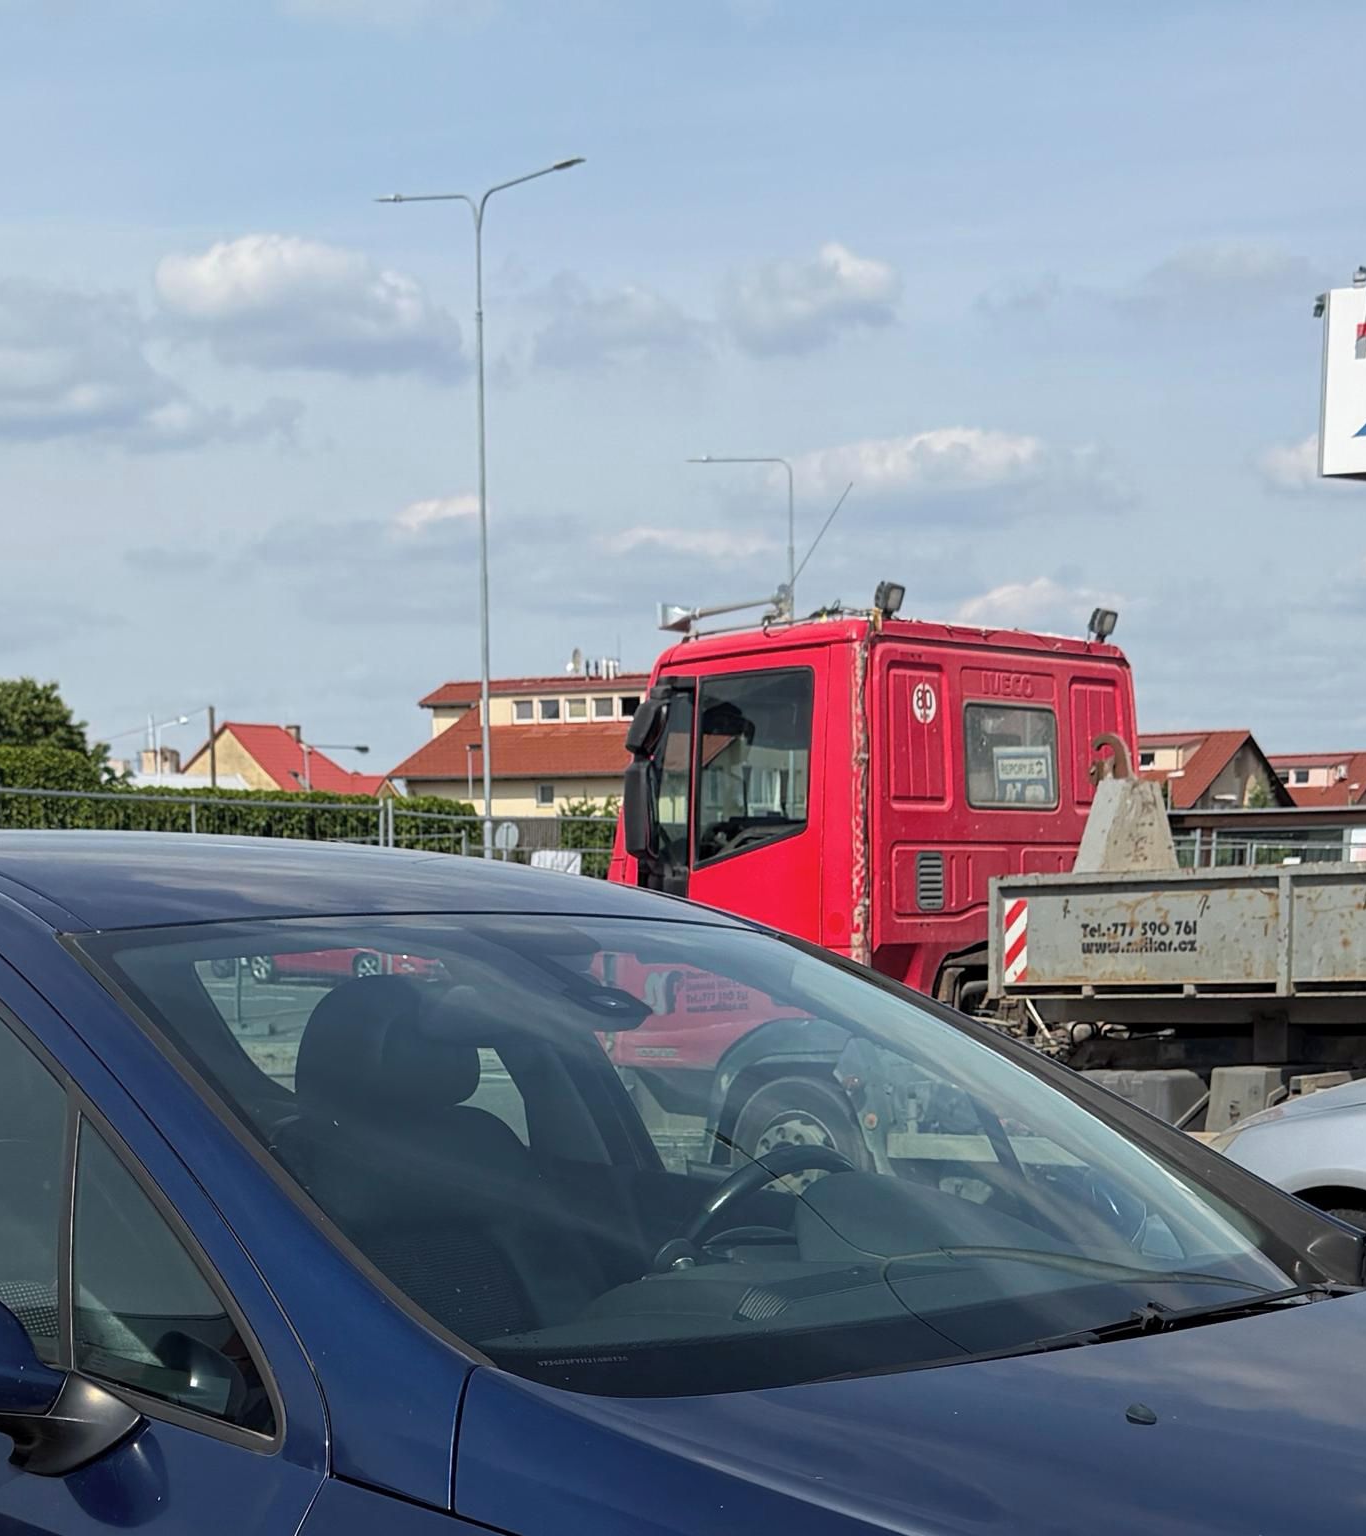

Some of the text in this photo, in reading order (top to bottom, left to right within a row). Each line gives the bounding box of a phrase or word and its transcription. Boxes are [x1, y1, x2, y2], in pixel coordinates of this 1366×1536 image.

[981, 671, 1034, 698] IVECO
[916, 689, 933, 710] 80
[1141, 921, 1170, 936] 590
[1174, 920, 1197, 936] 761
